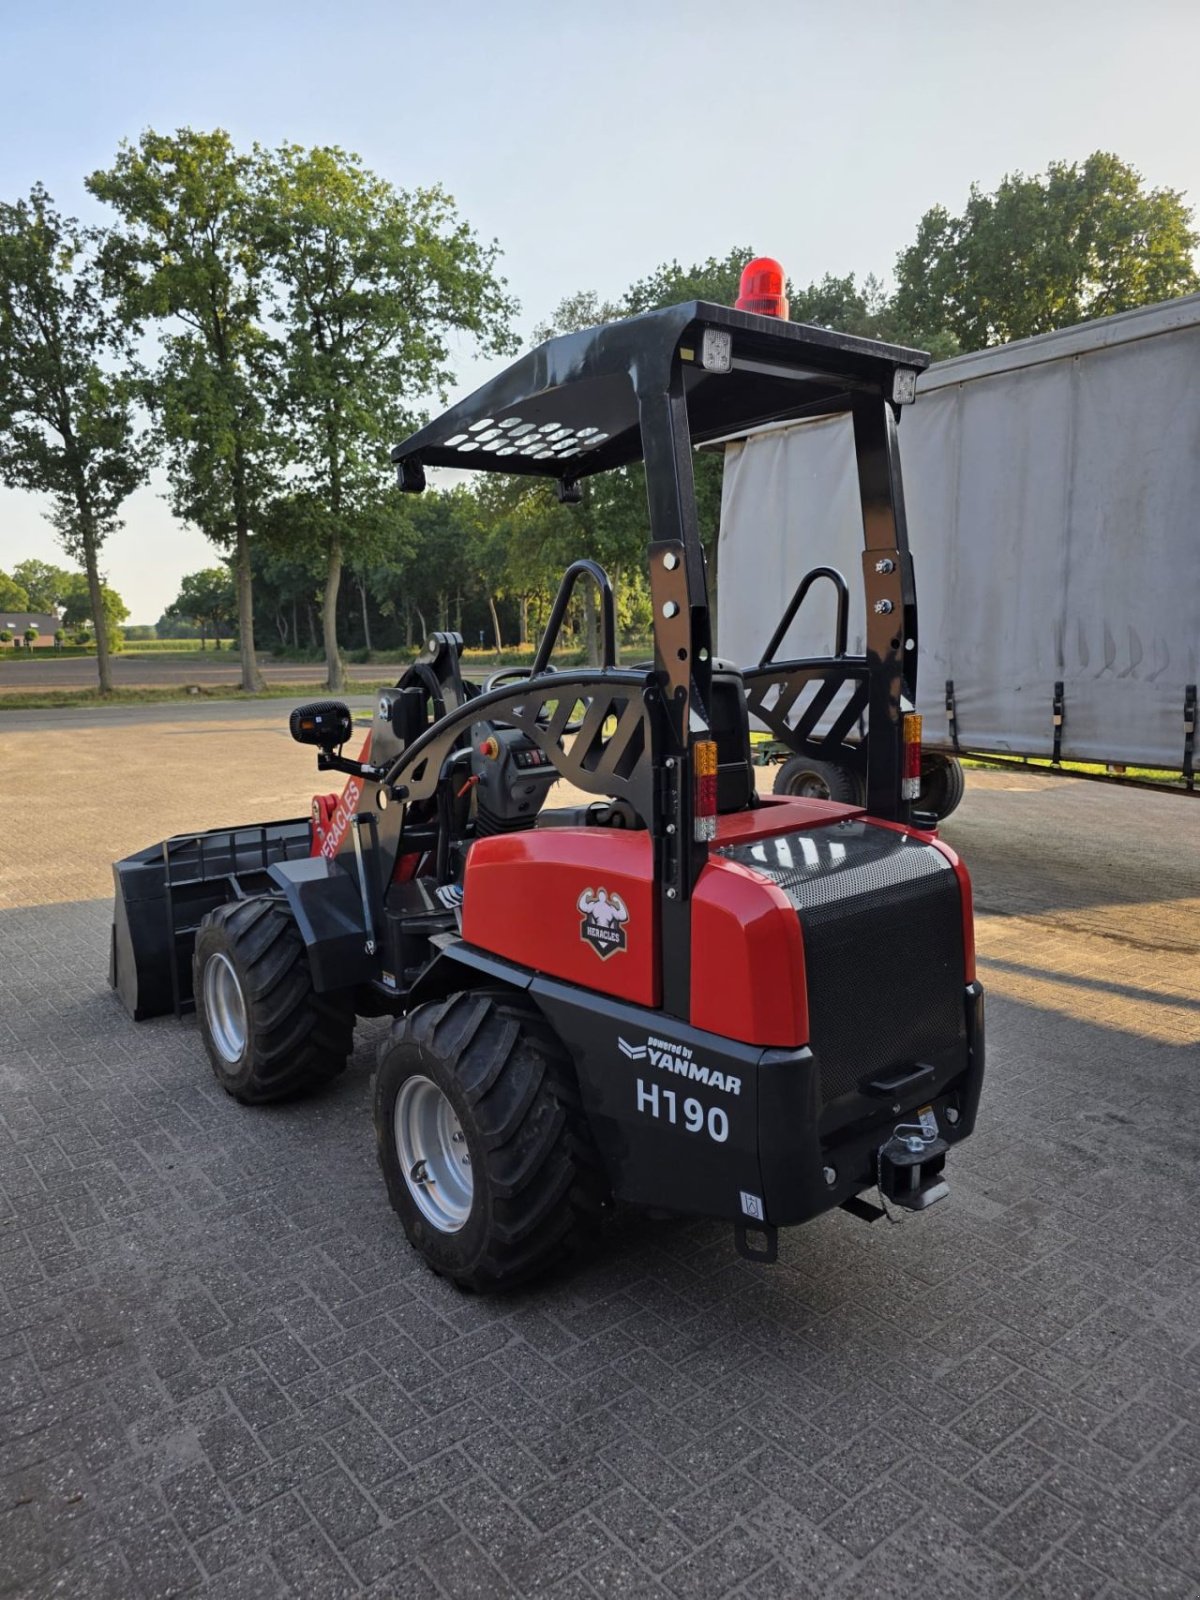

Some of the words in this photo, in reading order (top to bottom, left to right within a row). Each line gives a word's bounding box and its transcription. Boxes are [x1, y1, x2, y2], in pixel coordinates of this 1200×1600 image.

[587, 926, 620, 943] HERACLES
[647, 1036, 682, 1055] powered
[682, 1046, 693, 1060] by
[647, 1048, 742, 1096] YANMAR
[636, 1078, 729, 1143] H190
